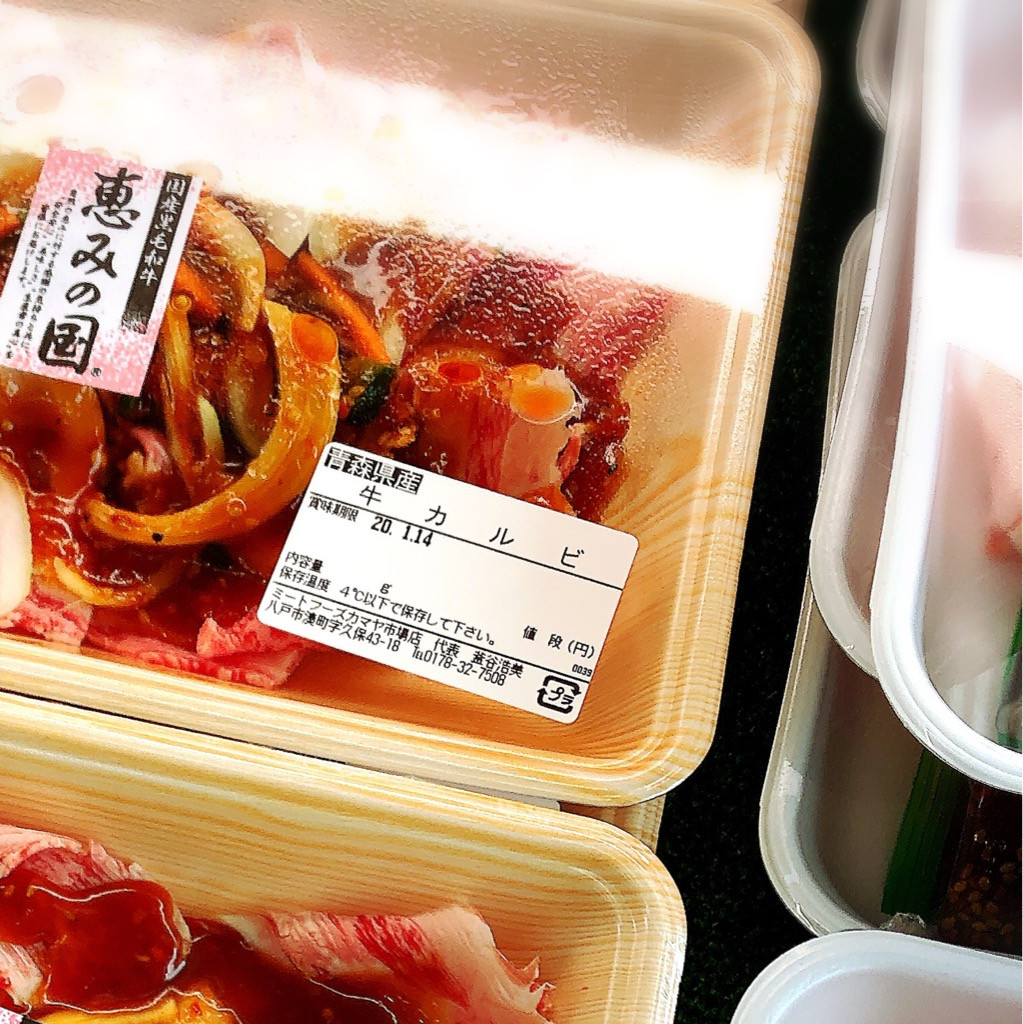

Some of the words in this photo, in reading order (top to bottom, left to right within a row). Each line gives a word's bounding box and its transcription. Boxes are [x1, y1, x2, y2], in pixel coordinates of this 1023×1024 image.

[38, 167, 143, 374] 恵みの国
[322, 447, 424, 494] 青森県産
[286, 552, 323, 573] 内容量
[280, 566, 330, 592] 保存温度
[431, 638, 464, 658] 代表
[572, 664, 595, 680] 0039
